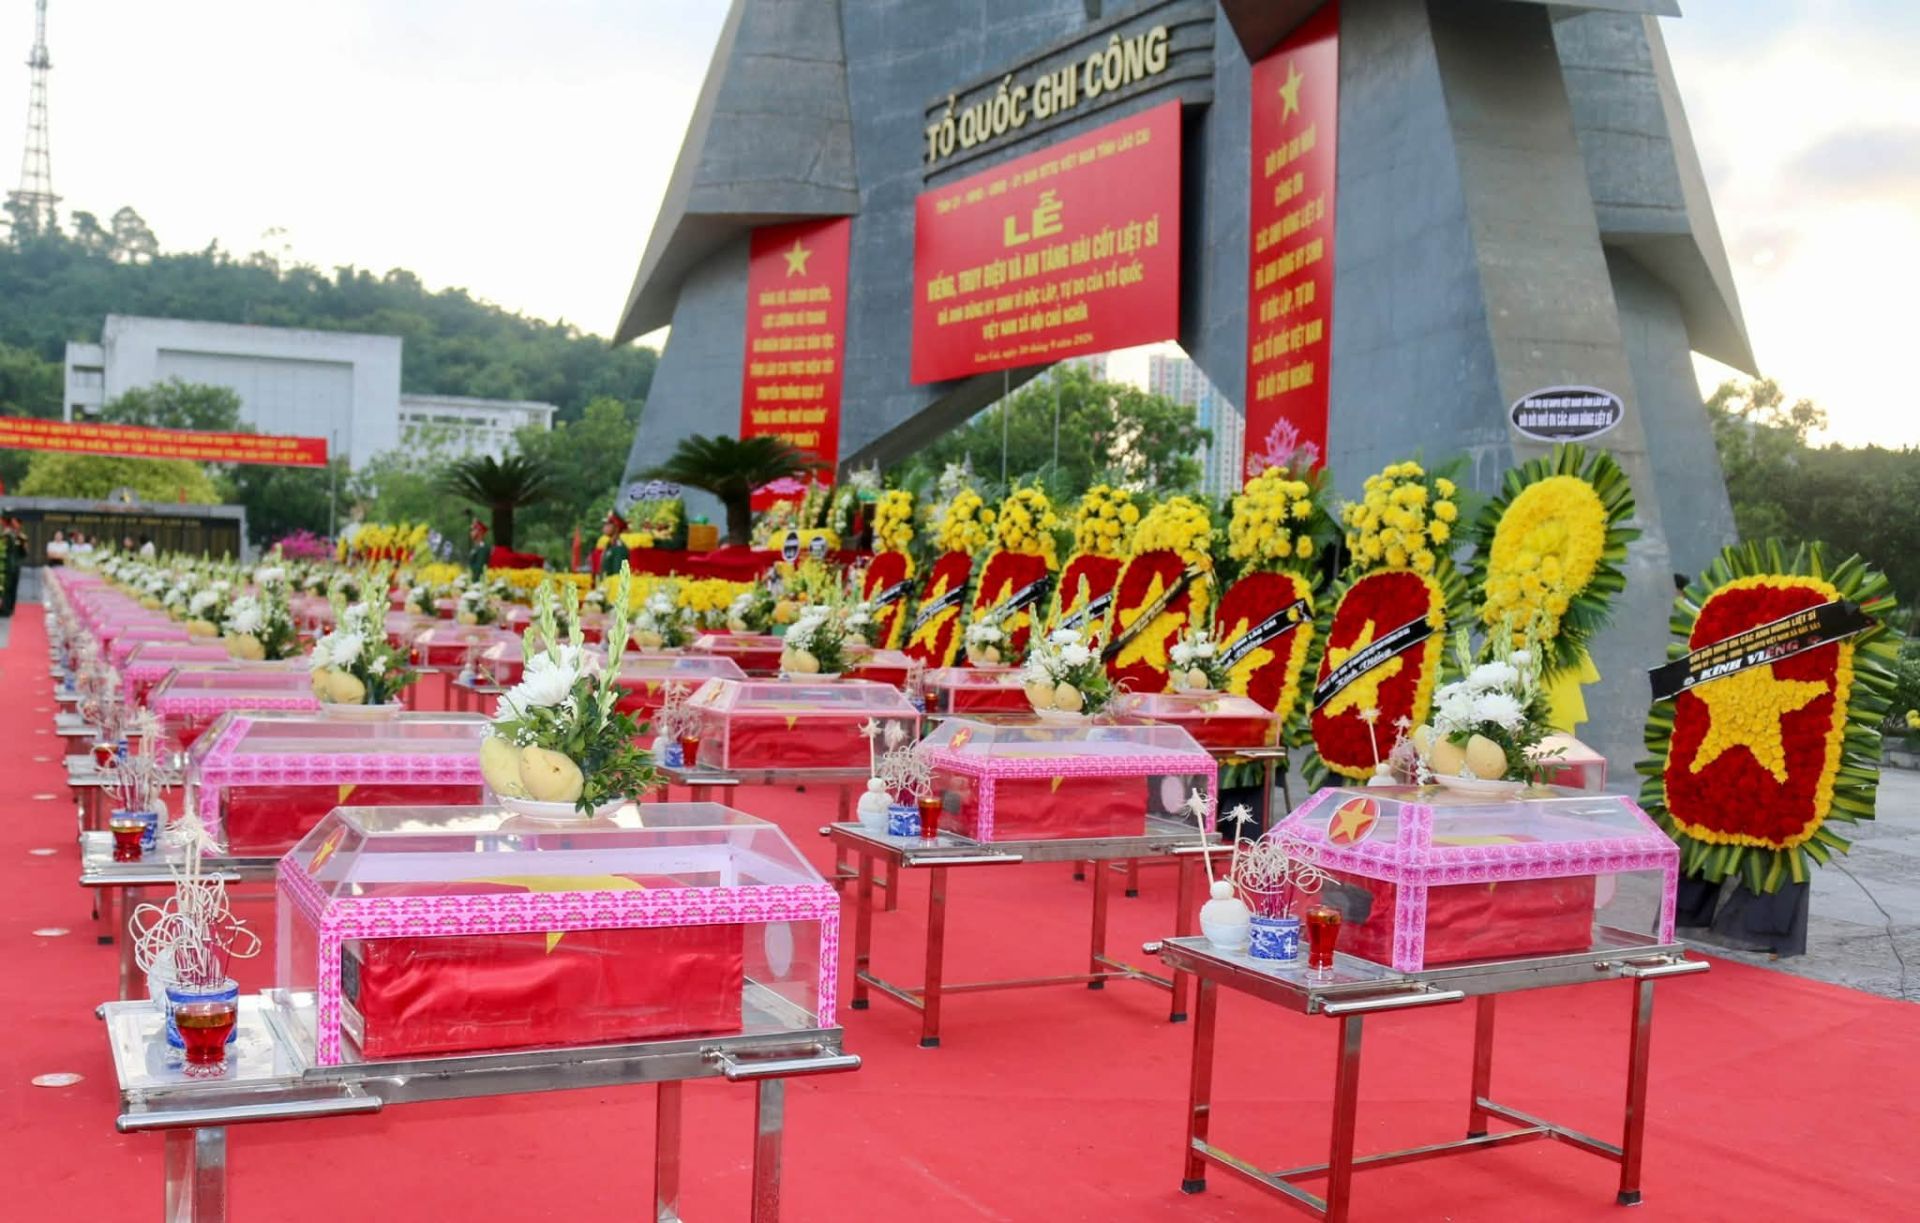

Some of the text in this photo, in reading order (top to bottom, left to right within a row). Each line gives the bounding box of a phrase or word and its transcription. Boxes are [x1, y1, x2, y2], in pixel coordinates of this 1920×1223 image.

[926, 24, 1168, 162] TỔ QUỐC GHI CÔNG
[1003, 189, 1063, 247] LỄ
[1117, 222, 1142, 254] LIỆT
[1700, 657, 1742, 681] KÍNH
